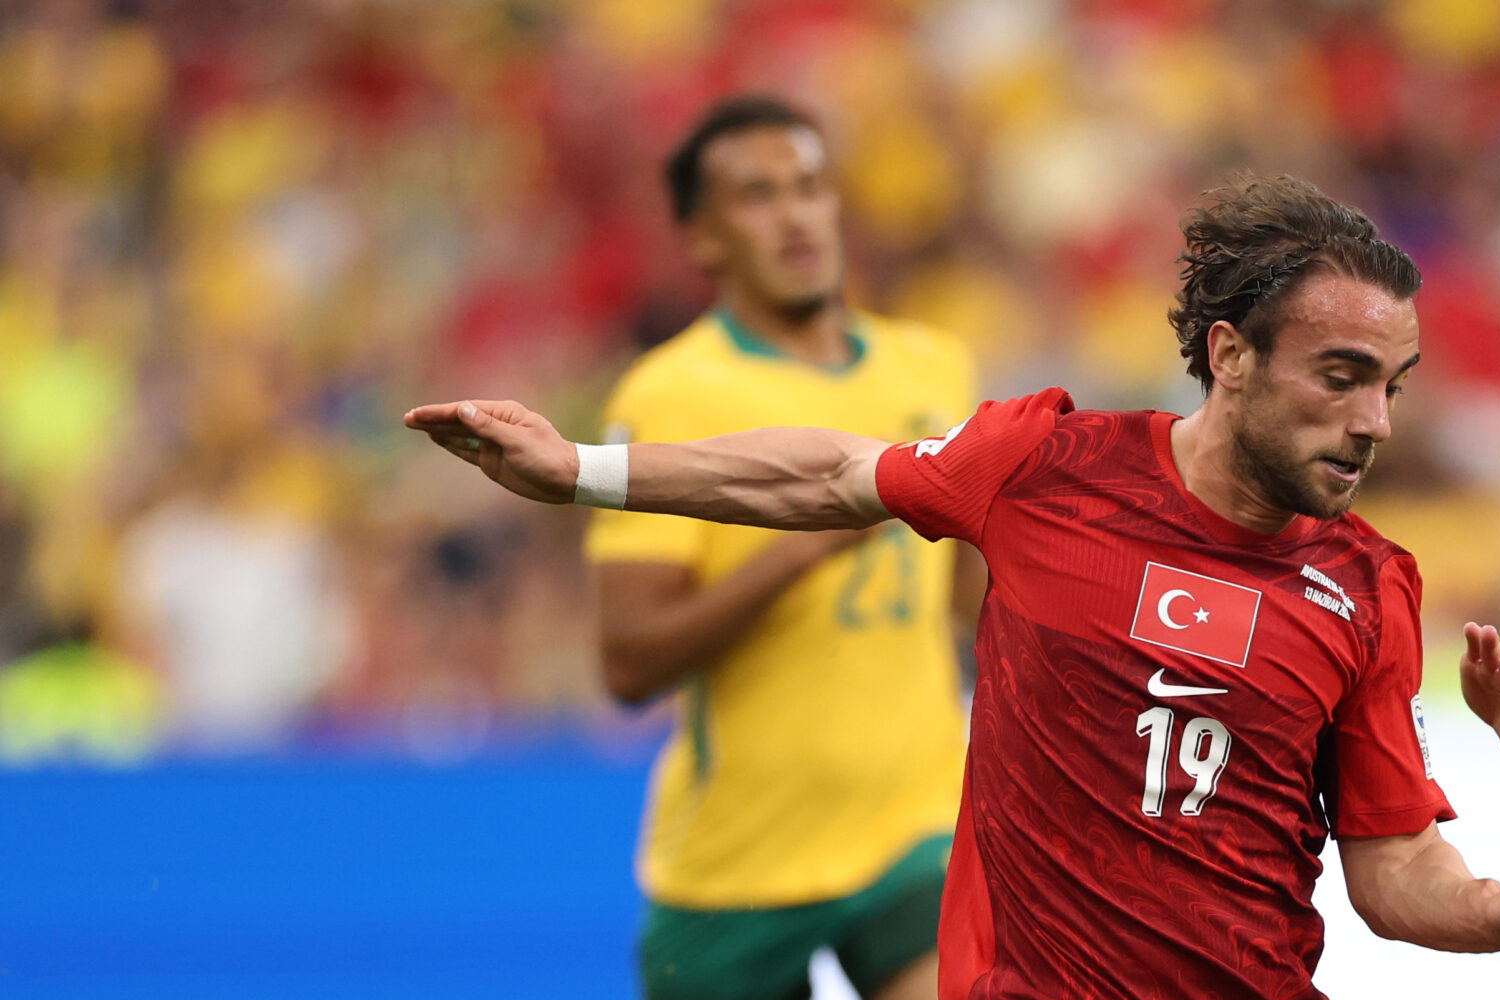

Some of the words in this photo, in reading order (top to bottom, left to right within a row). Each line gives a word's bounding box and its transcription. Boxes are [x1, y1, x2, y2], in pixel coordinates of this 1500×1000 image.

[1304, 585, 1314, 600] 13
[1311, 589, 1341, 614] HAZİRAN
[1136, 706, 1232, 817] 19
